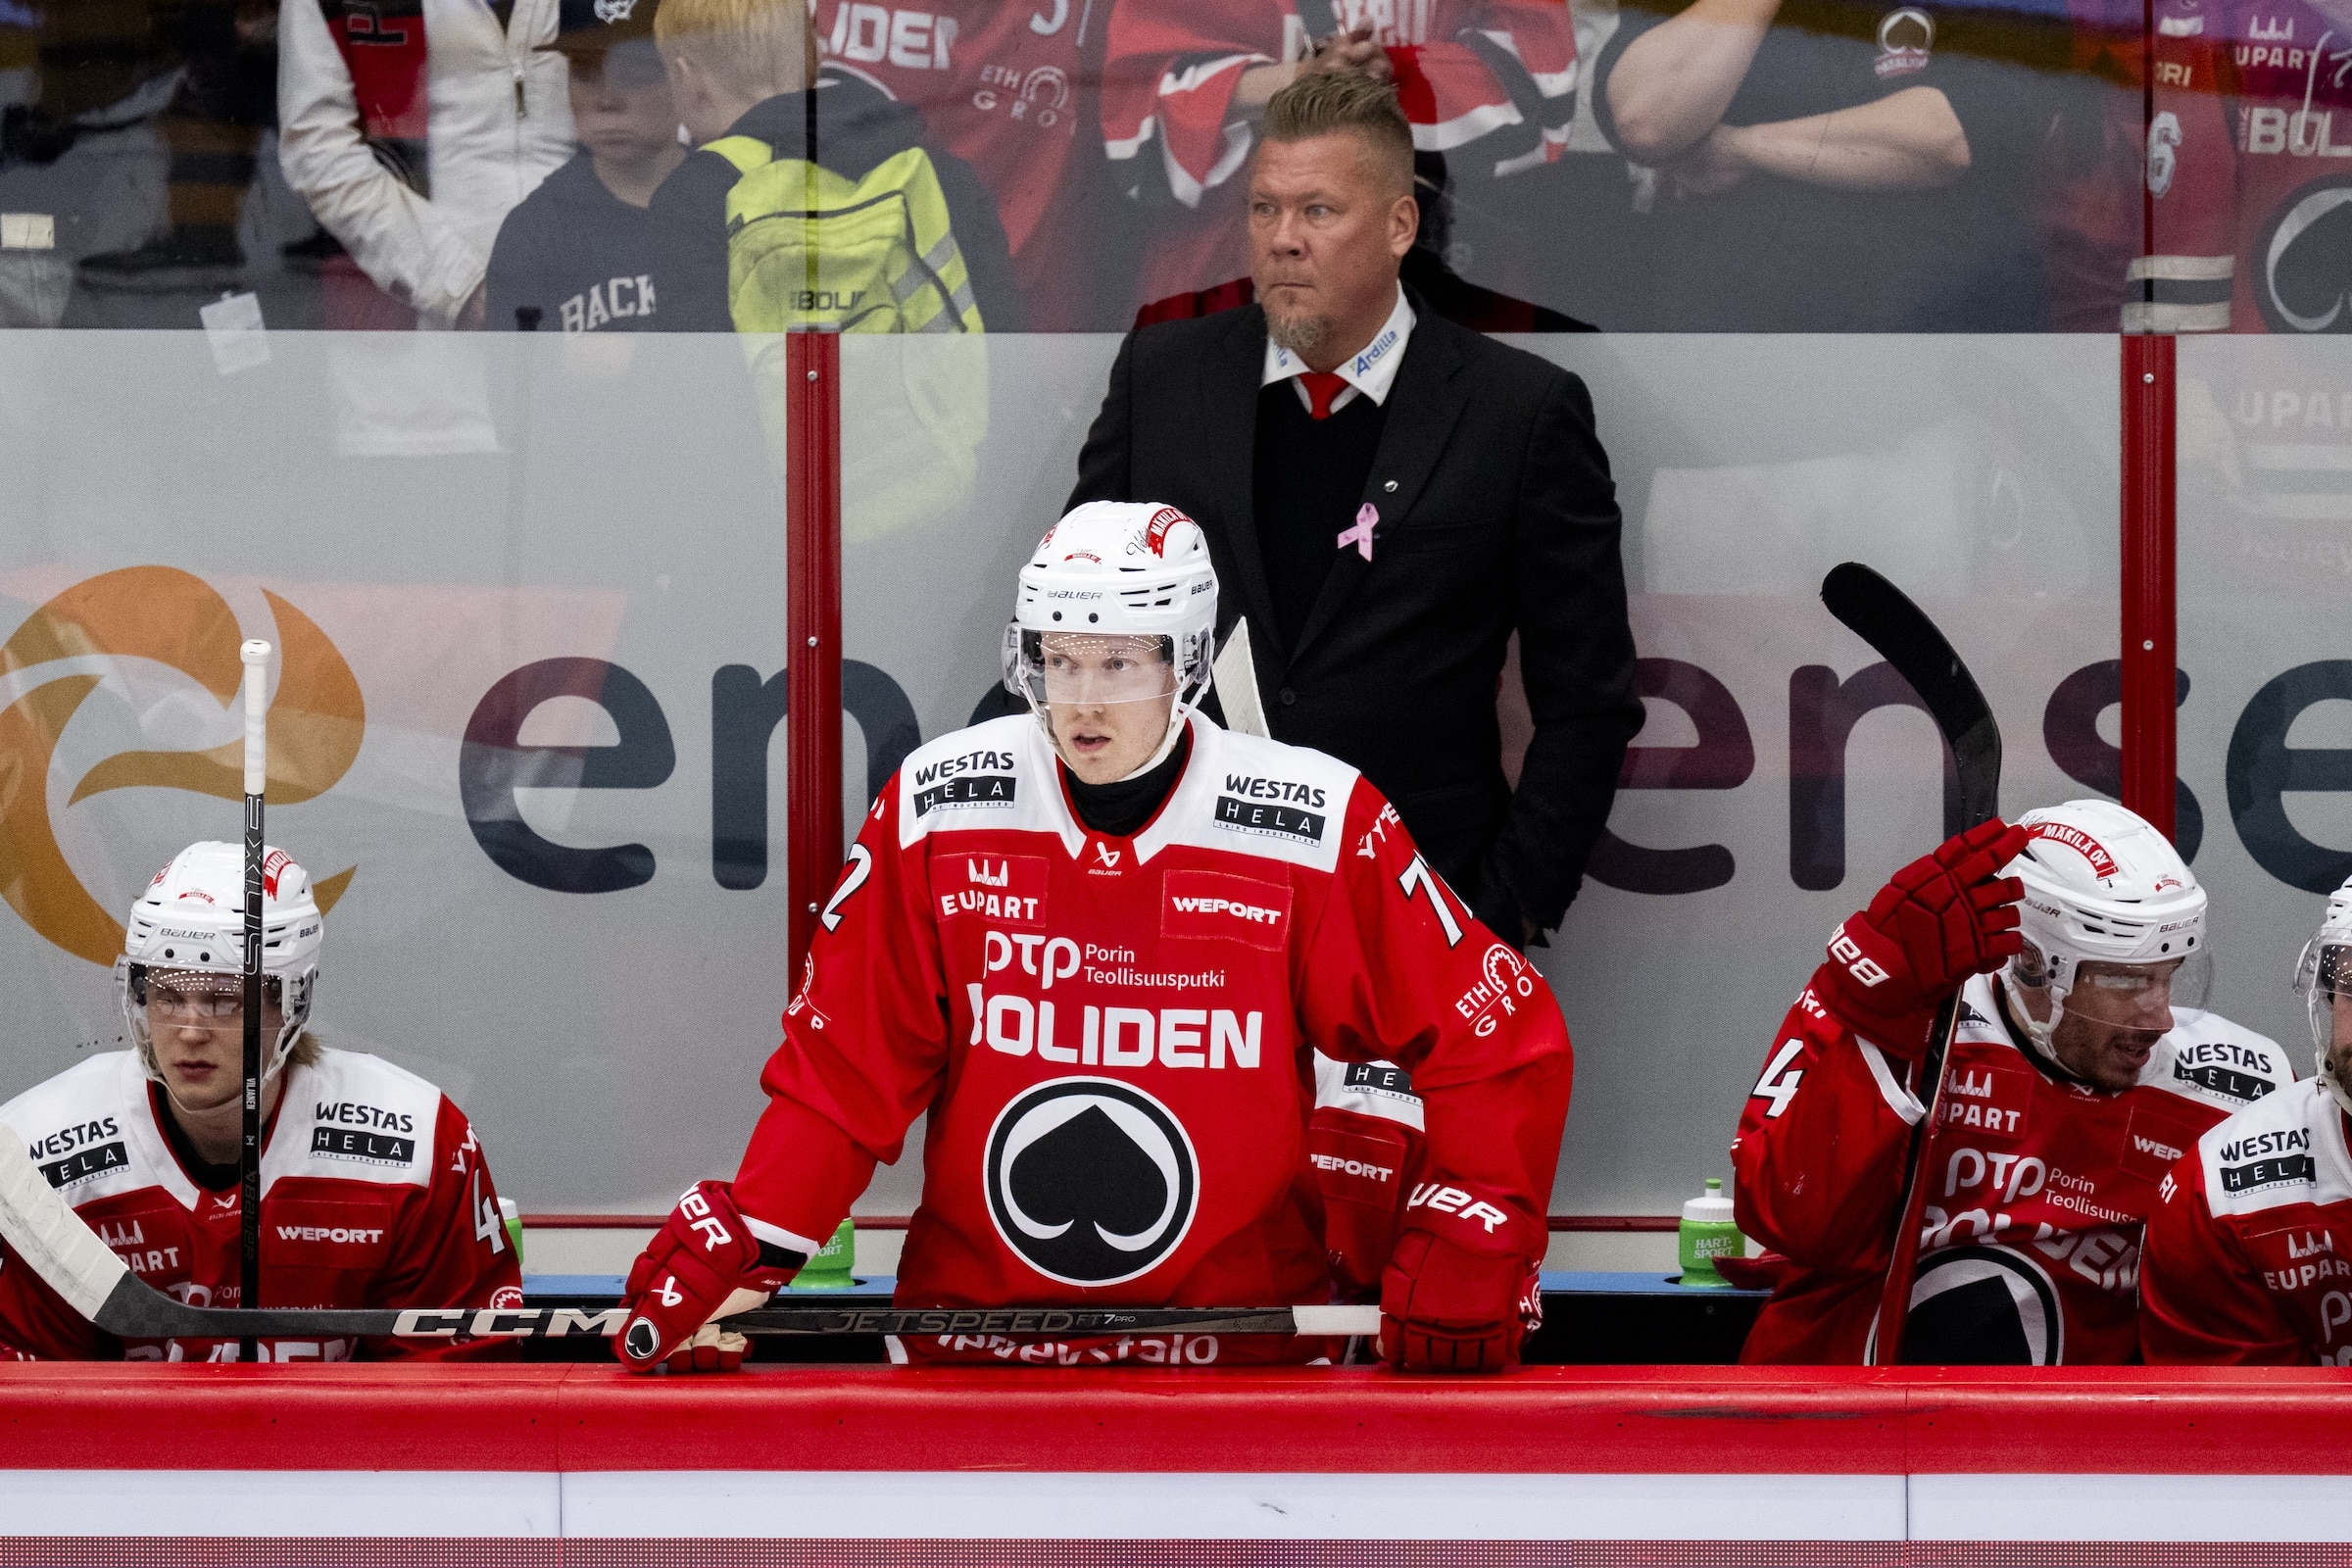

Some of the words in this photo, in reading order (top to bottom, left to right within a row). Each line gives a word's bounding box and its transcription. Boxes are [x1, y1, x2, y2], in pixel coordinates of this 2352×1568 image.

[1356, 329, 1398, 377] Ardilla
[915, 750, 1015, 786] WESTAS
[923, 780, 1004, 809] HELA
[1226, 773, 1326, 808] WESTAS
[1226, 802, 1311, 833] HELA
[1253, 828, 1314, 845] INDUSTRIES
[2043, 823, 2096, 854] MÄKILÄ
[939, 889, 1039, 921] EUPART
[1171, 896, 1283, 926] WEPORT
[1397, 851, 1473, 951] 7
[1085, 943, 1136, 963] Porin
[1083, 965, 1226, 992] Teollisuusputki
[1750, 1037, 1806, 1119] 4
[317, 1102, 414, 1133] WESTAS
[318, 1132, 403, 1157] HELA
[2220, 1127, 2310, 1162] WESTAS
[43, 1148, 118, 1181] ELA
[1309, 1153, 1394, 1183] EPORT
[2048, 1167, 2096, 1196] Porin
[276, 1225, 384, 1245] WEPORT
[817, 1244, 844, 1257] ORT
[391, 1308, 633, 1338] CCM
[821, 1311, 1074, 1334] JETSPEED
